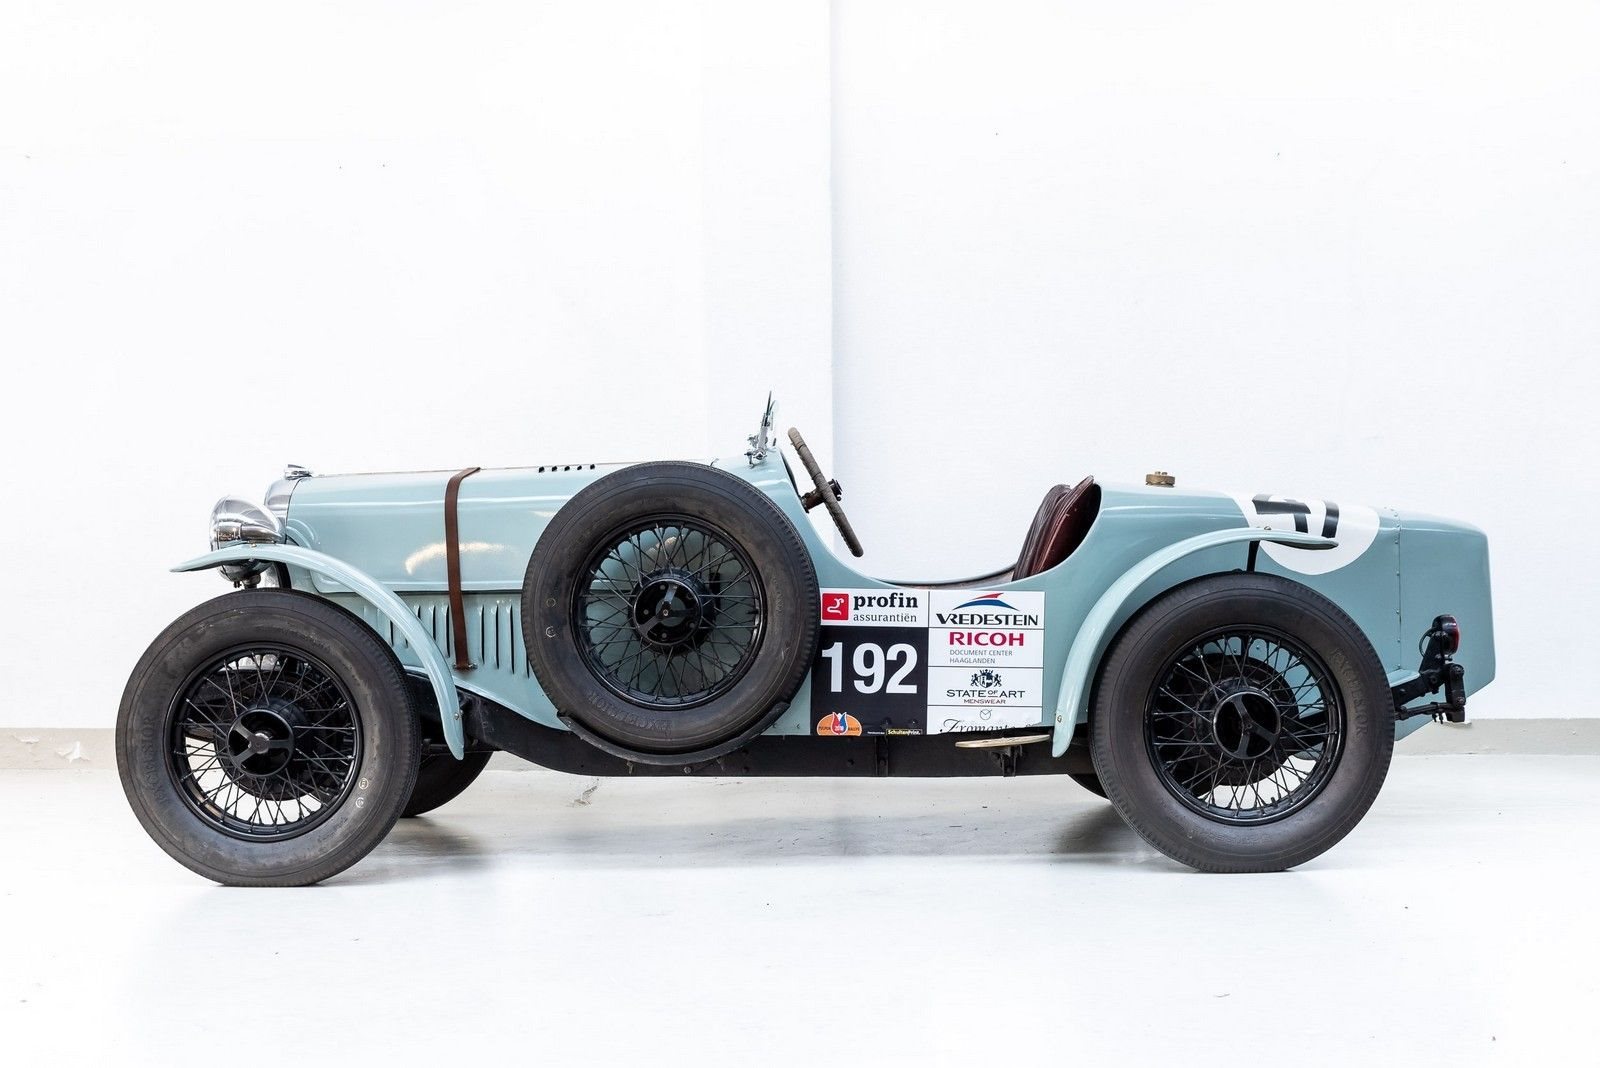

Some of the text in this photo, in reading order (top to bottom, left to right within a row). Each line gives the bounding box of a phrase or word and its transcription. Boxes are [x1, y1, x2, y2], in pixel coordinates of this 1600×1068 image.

[853, 592, 918, 610] profin
[853, 612, 917, 623] assurantiën
[936, 613, 1038, 626] VREDESTEIN
[949, 632, 1024, 647] RICOH
[949, 649, 1013, 657] DOCUMENT CENTER
[821, 641, 918, 694] 192
[946, 689, 986, 698] STATE
[999, 690, 1026, 698] ART
